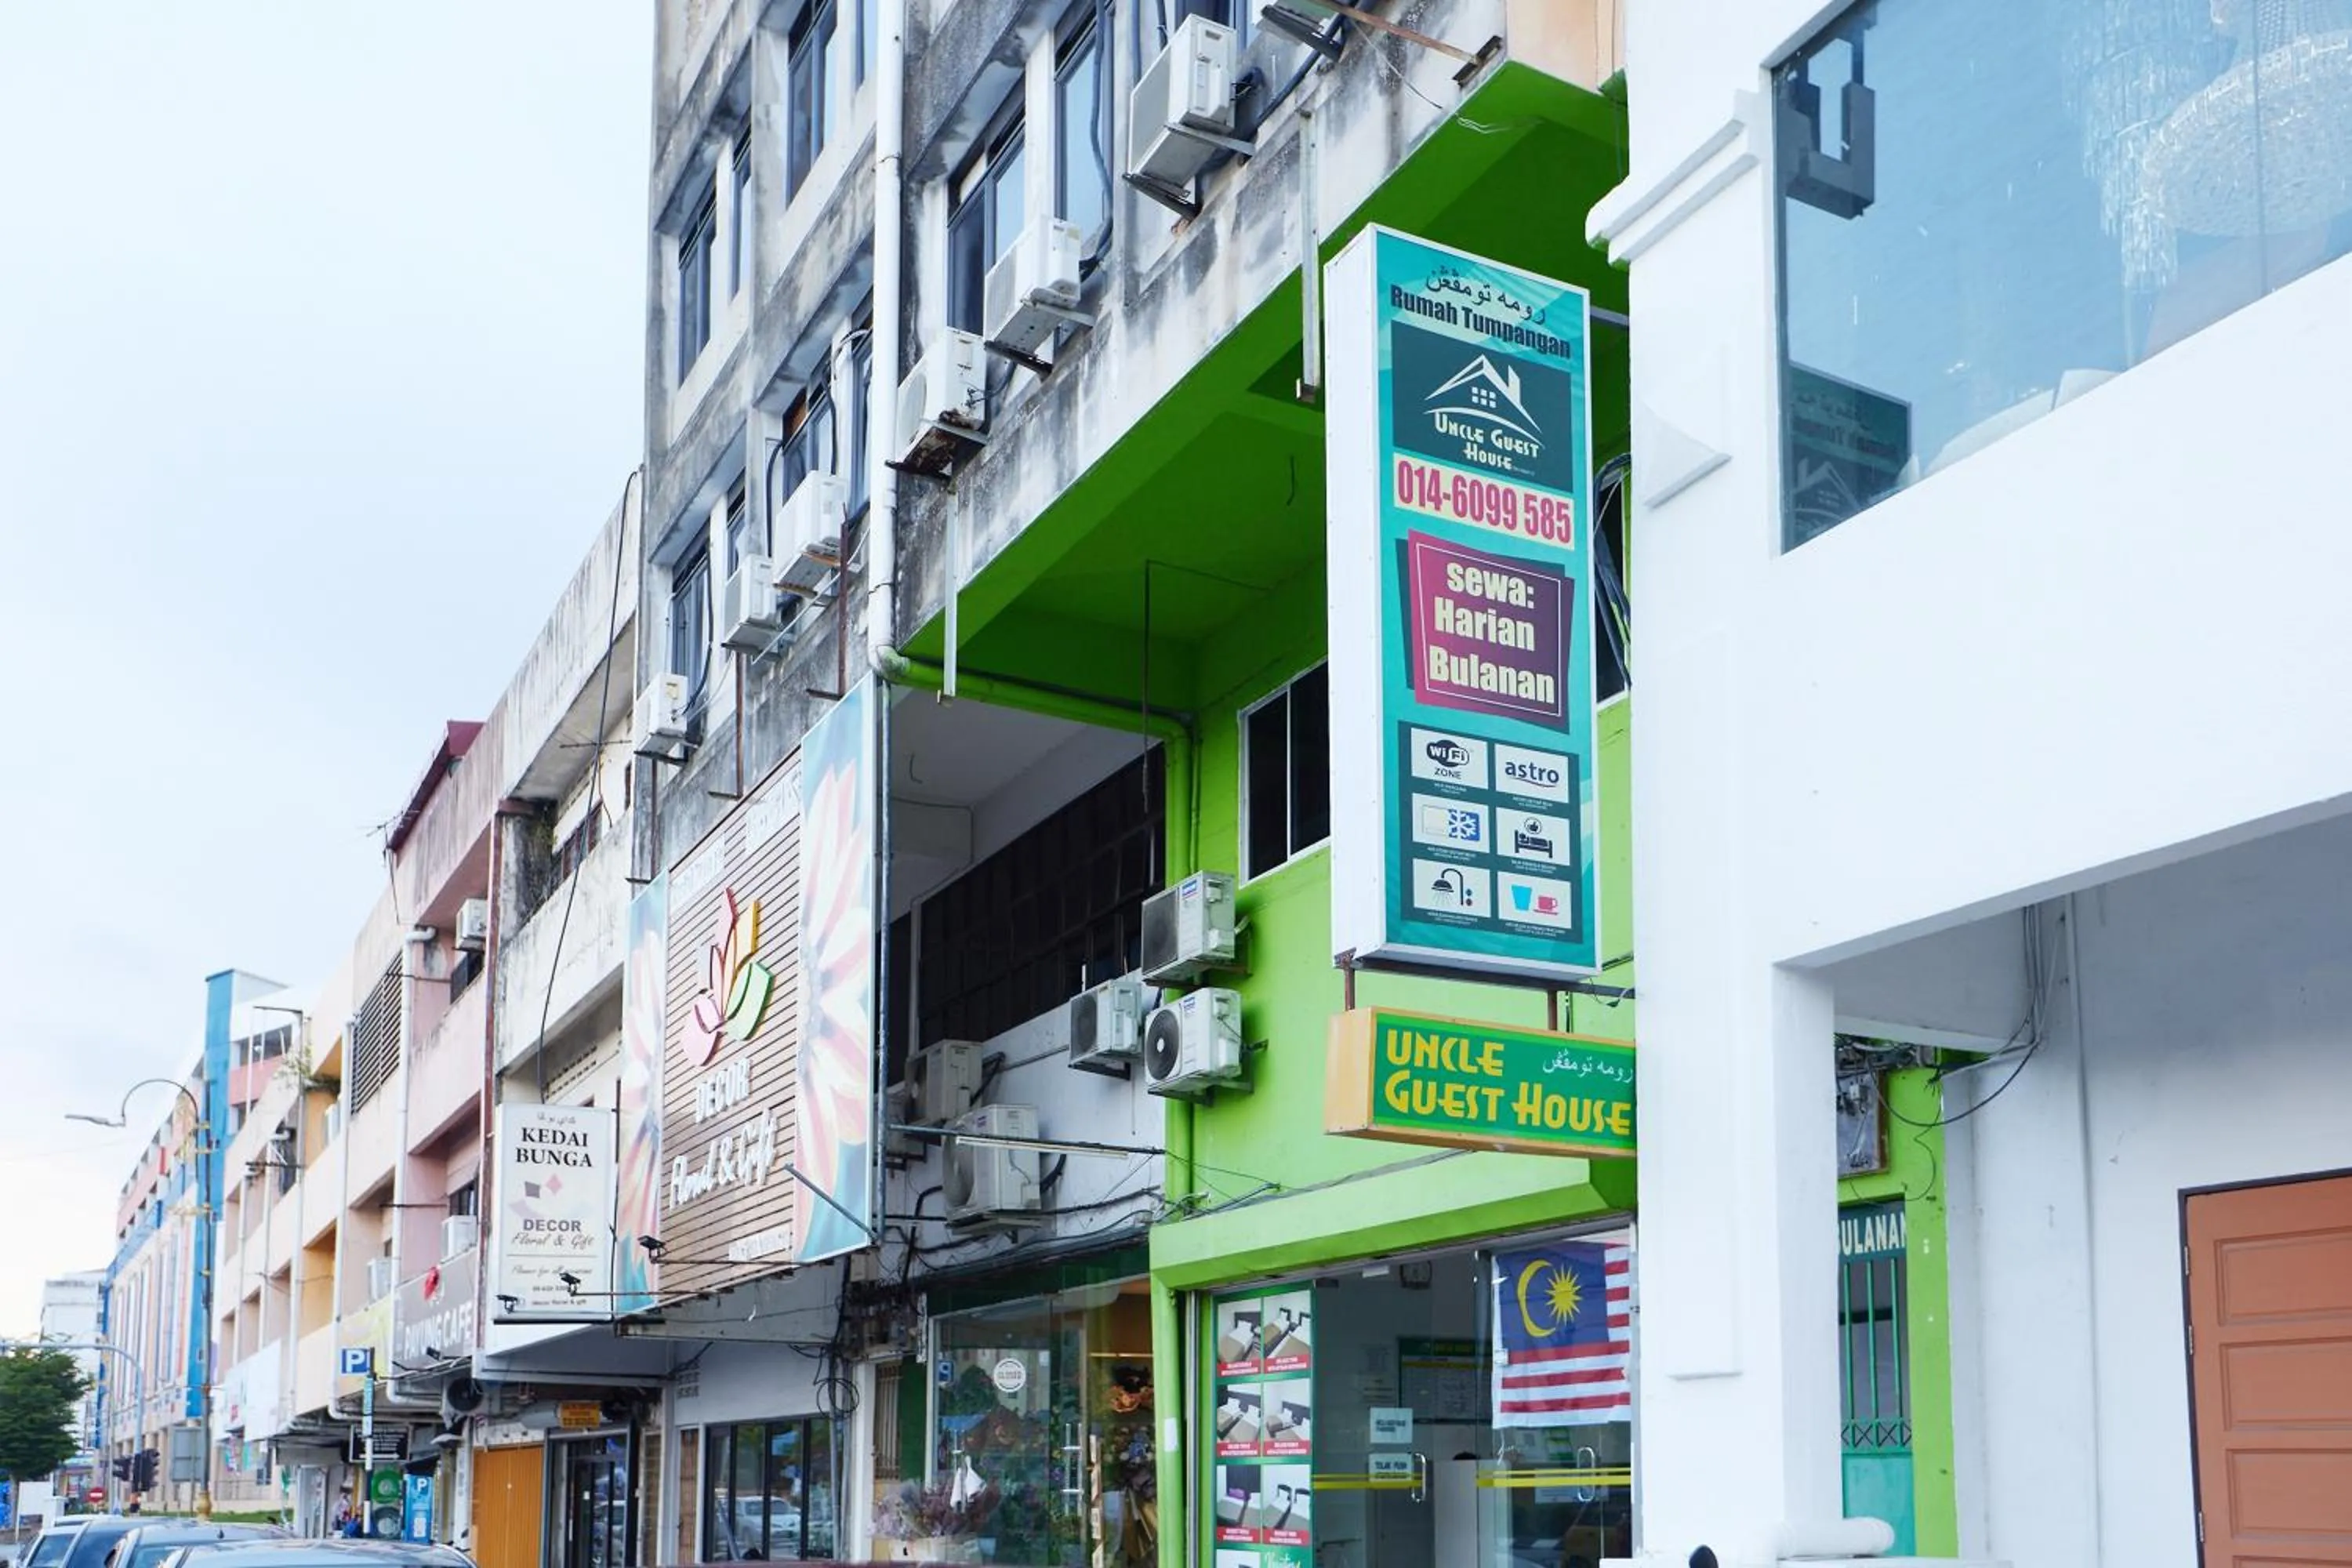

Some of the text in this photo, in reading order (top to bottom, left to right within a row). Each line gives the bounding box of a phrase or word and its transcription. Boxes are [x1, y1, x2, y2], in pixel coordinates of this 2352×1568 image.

[1391, 284, 1571, 359] Rumah Tumpangan
[1398, 459, 1571, 543] 014-6099 585
[1434, 596, 1535, 651] Harian
[1429, 645, 1555, 704] Bulanan
[1434, 768, 1461, 779] ZONE
[1505, 760, 1559, 783] astro
[695, 1058, 750, 1123] DECOR
[521, 1127, 588, 1147] KEDAI
[516, 1147, 592, 1167] BUNGA
[523, 1218, 582, 1232] DECOR
[444, 1301, 472, 1348] CAFE
[347, 1350, 365, 1373] P
[416, 1478, 427, 1492] P
